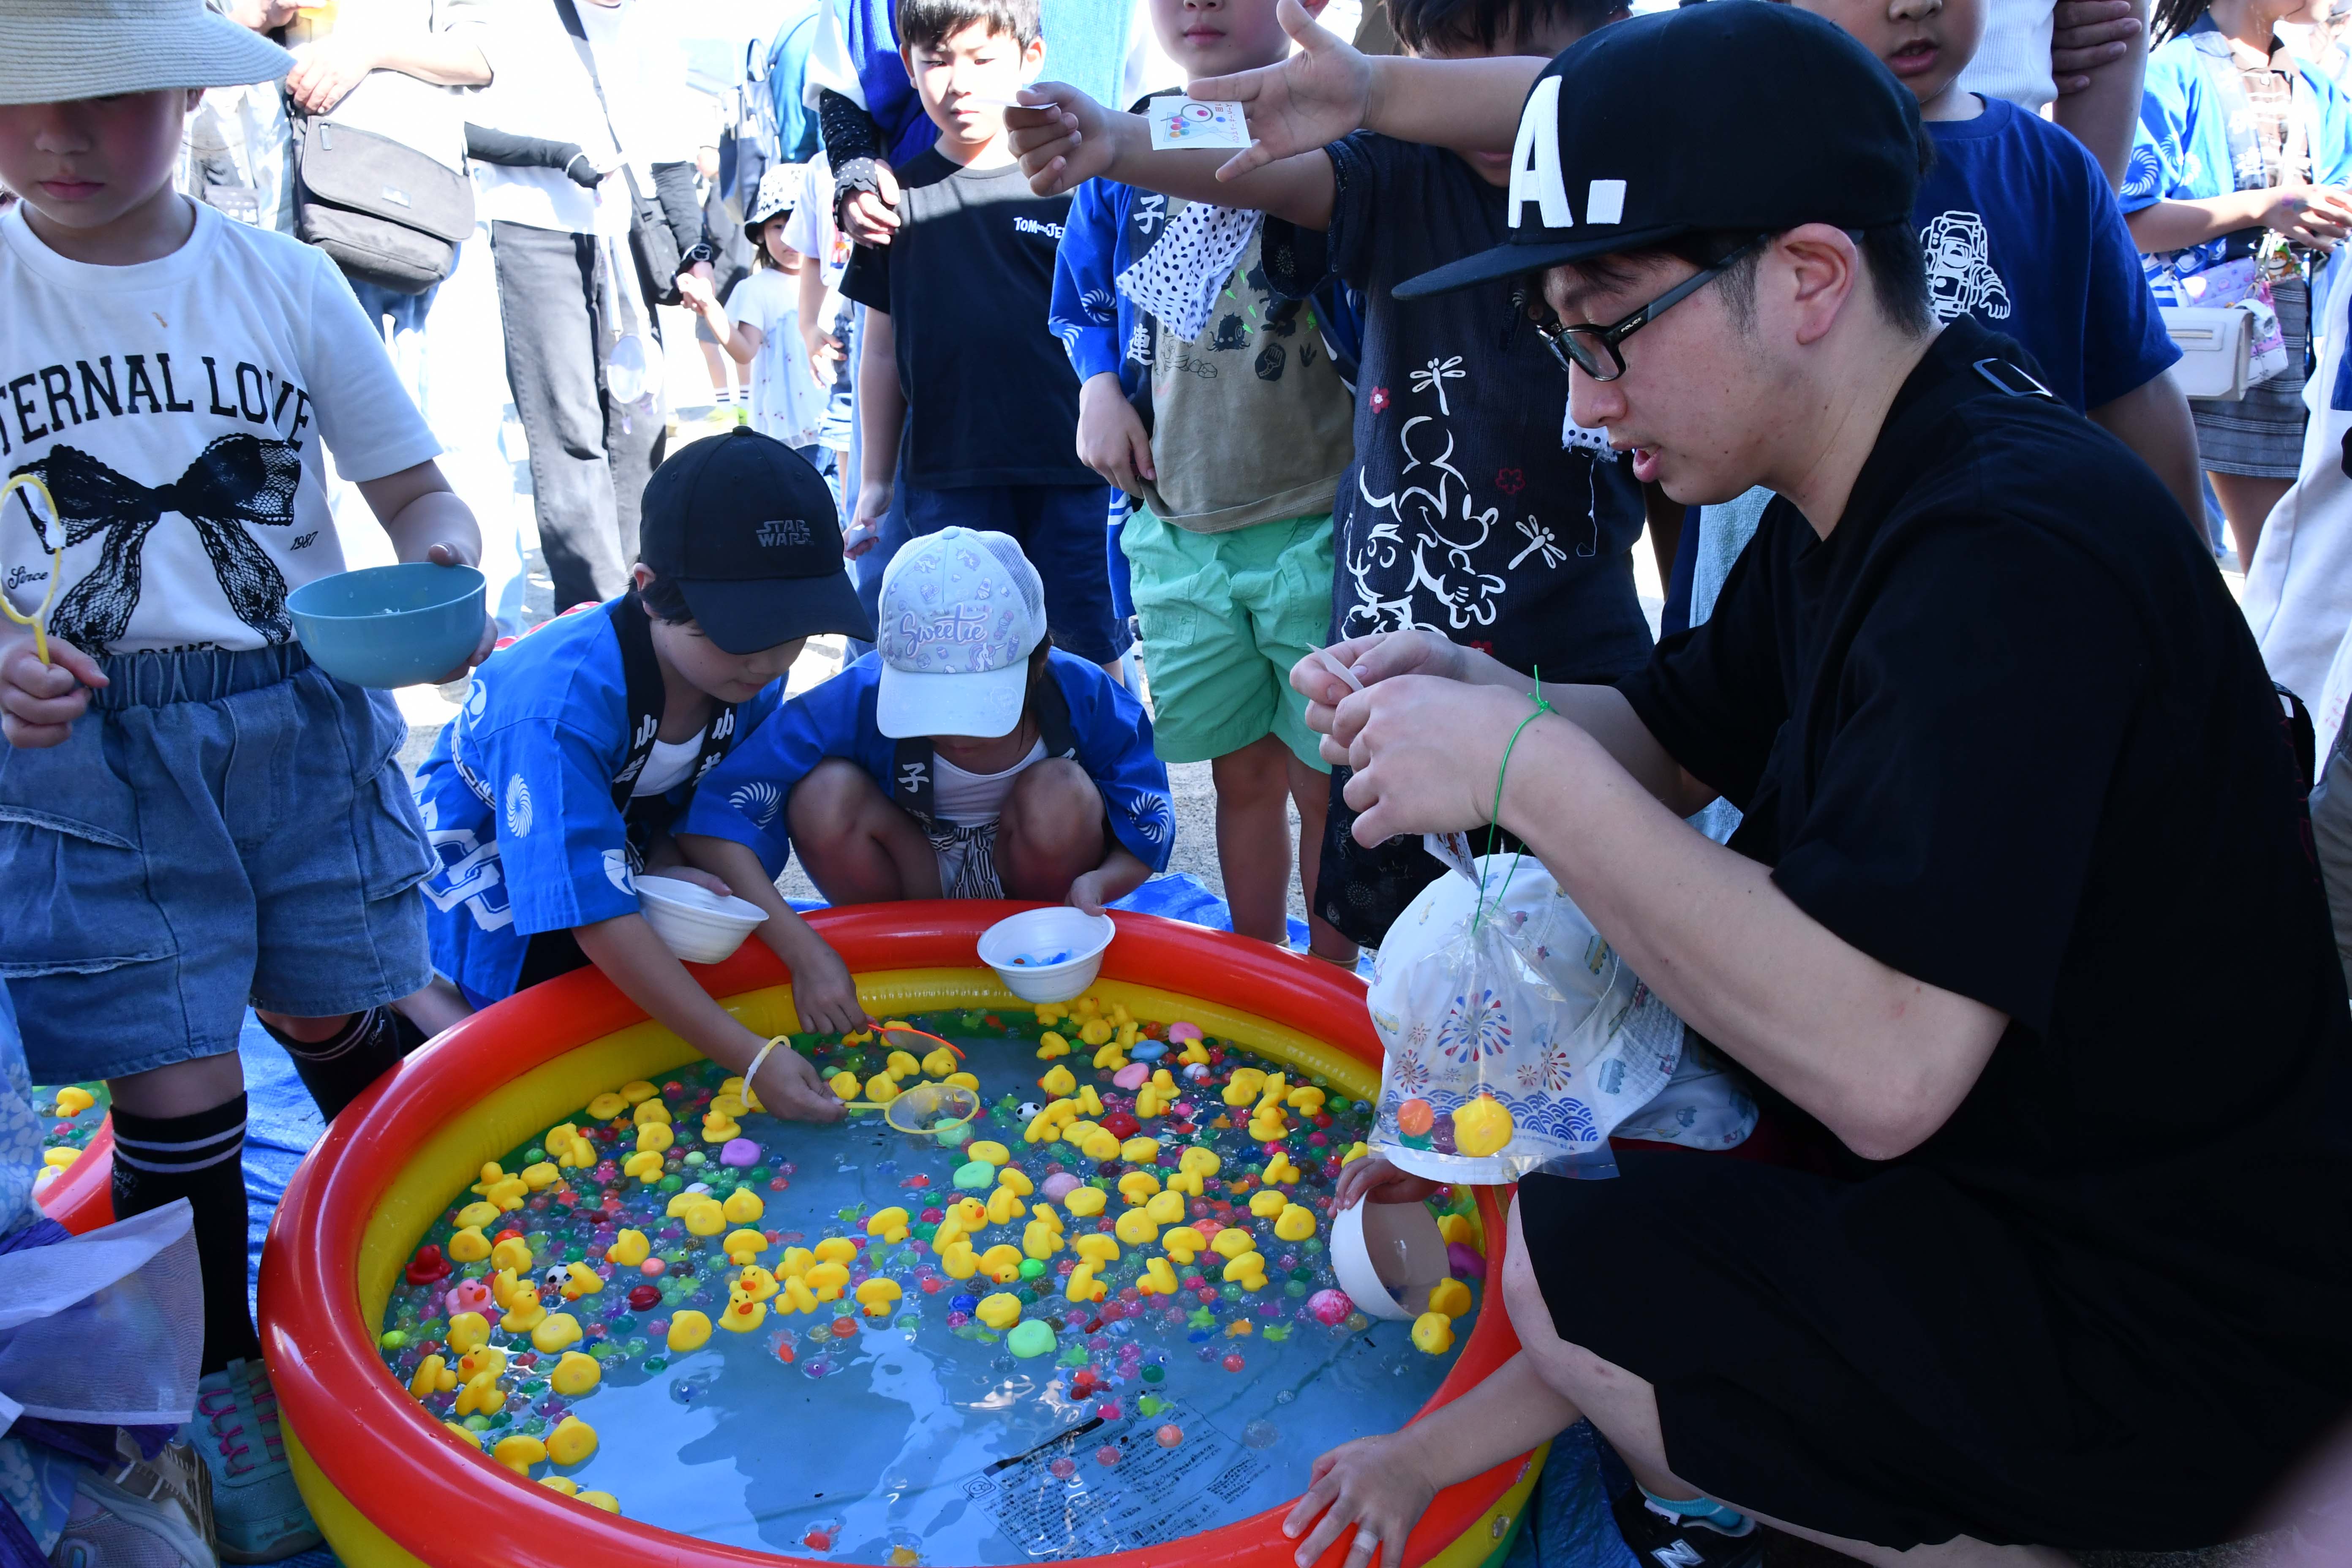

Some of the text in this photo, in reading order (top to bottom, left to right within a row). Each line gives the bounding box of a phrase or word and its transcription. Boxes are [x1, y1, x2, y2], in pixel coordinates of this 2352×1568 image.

[201, 356, 312, 452] LOVE
[756, 520, 810, 534] STAR
[290, 531, 318, 551] 1987
[758, 533, 811, 547] WARS
[8, 566, 49, 589] Since
[899, 603, 988, 658] Sweetie
